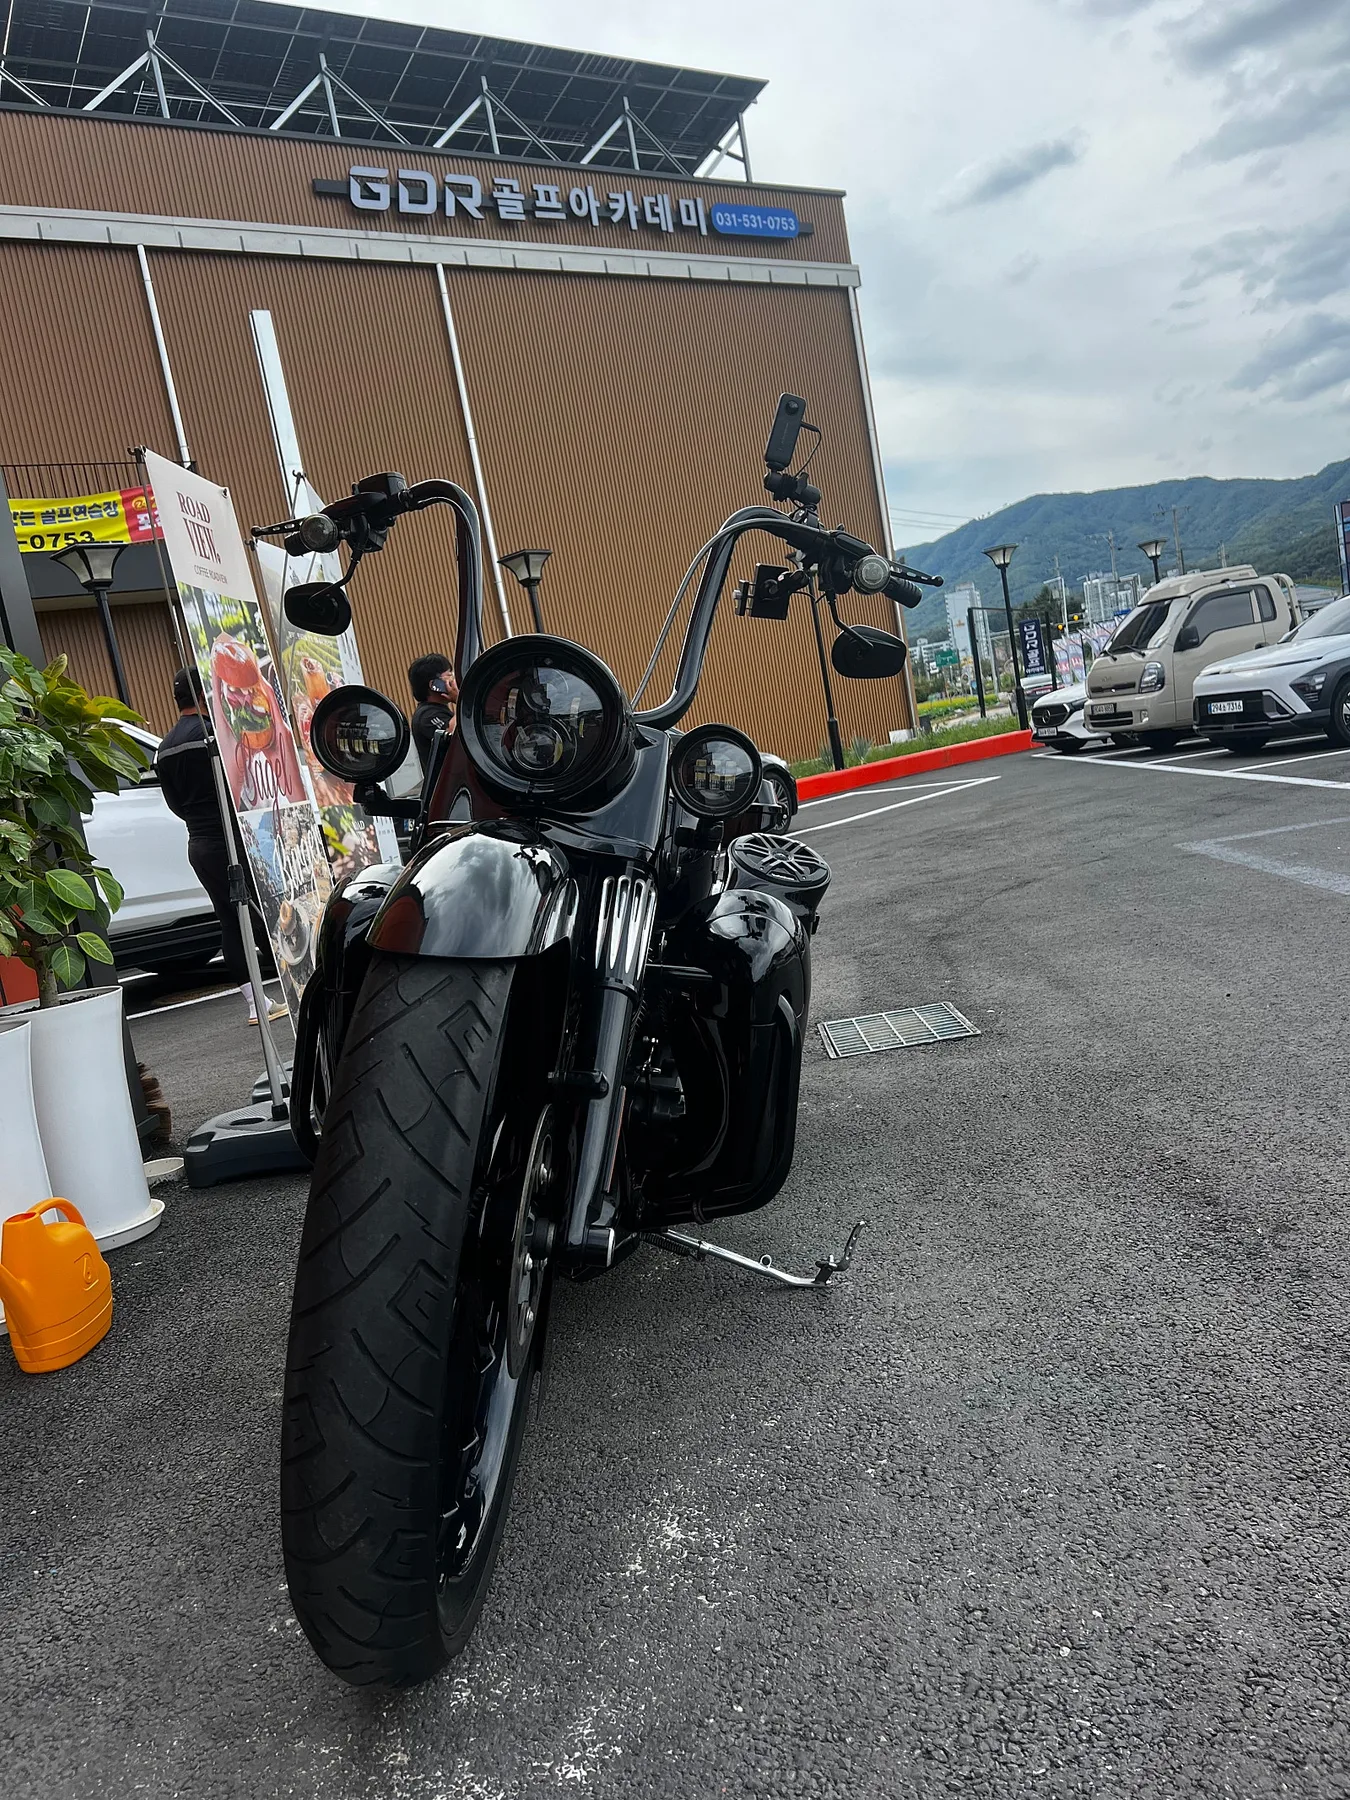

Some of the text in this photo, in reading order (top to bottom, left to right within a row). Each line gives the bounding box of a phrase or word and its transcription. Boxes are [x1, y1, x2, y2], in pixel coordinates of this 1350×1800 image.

[716, 211, 796, 232] 031-531-0753
[176, 490, 211, 524] ROAD
[235, 732, 293, 836] Bagel
